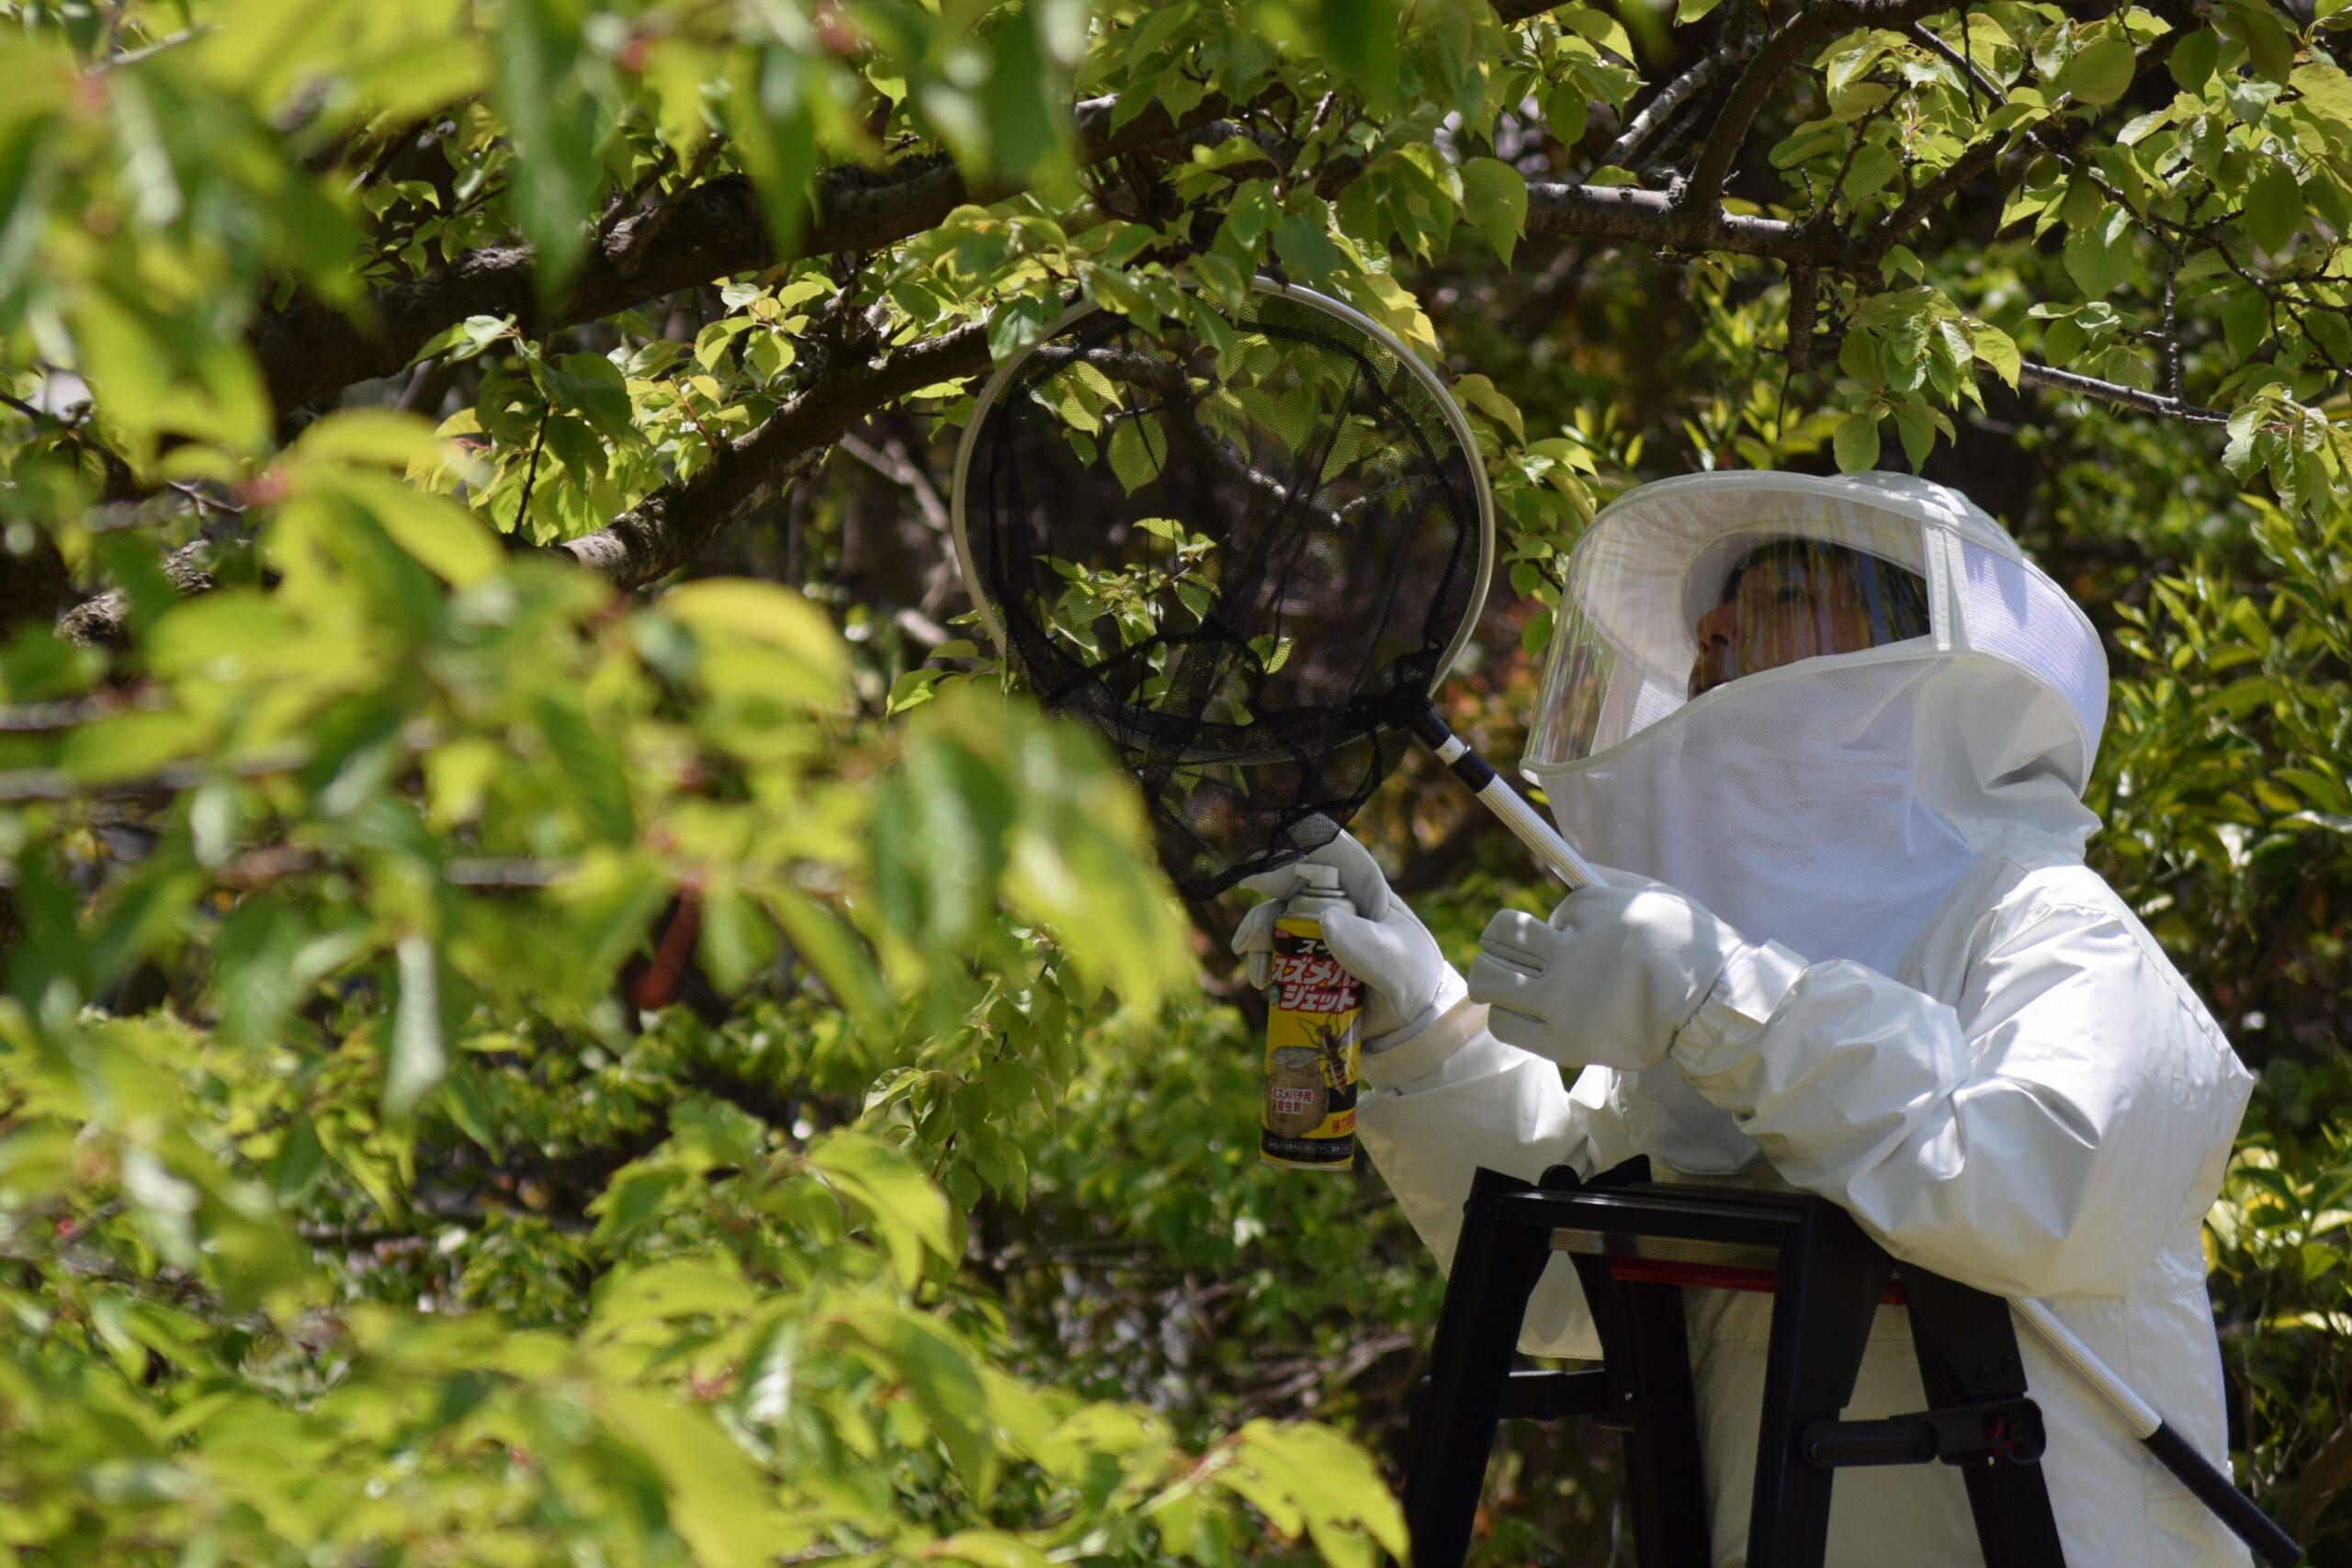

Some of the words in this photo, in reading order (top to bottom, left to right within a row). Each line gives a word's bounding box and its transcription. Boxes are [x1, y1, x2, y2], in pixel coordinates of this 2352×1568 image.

[1296, 939, 1332, 955] スー
[1280, 985, 1355, 1012] ジェット
[1272, 1088, 1312, 1103] スズメバチ用
